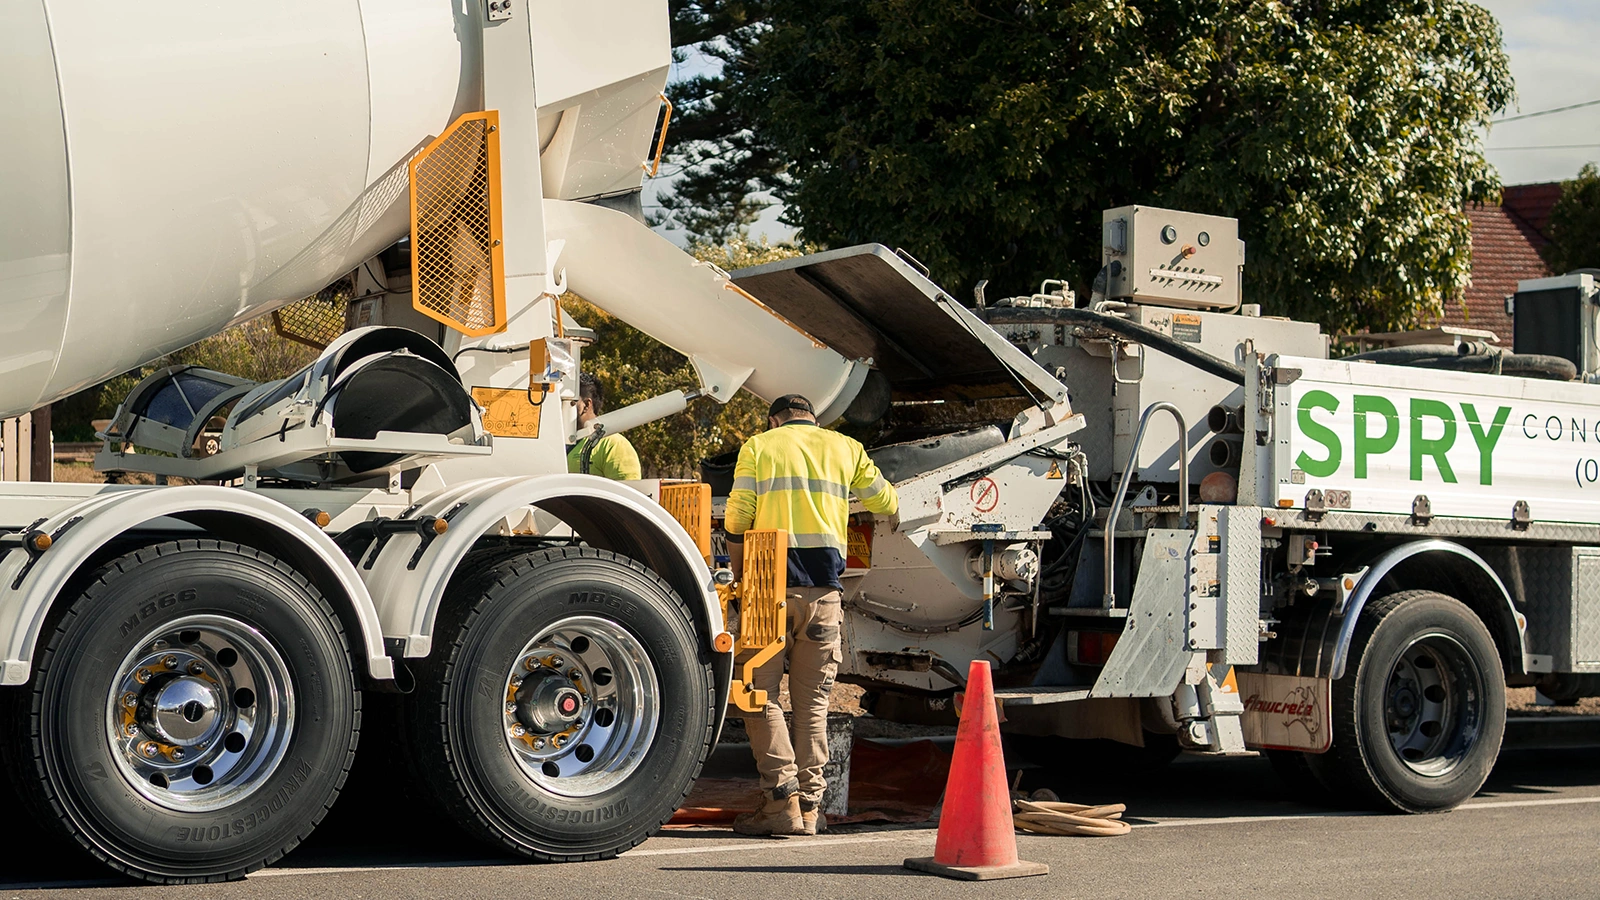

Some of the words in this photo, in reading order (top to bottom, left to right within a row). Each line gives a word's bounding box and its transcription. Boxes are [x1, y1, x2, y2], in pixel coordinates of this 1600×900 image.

[1295, 389, 1512, 486] SPRY
[118, 588, 197, 639] M866
[568, 590, 639, 618] M866
[177, 757, 312, 842] BRIDGESTONE
[503, 780, 631, 824] BRIDGESTONE
